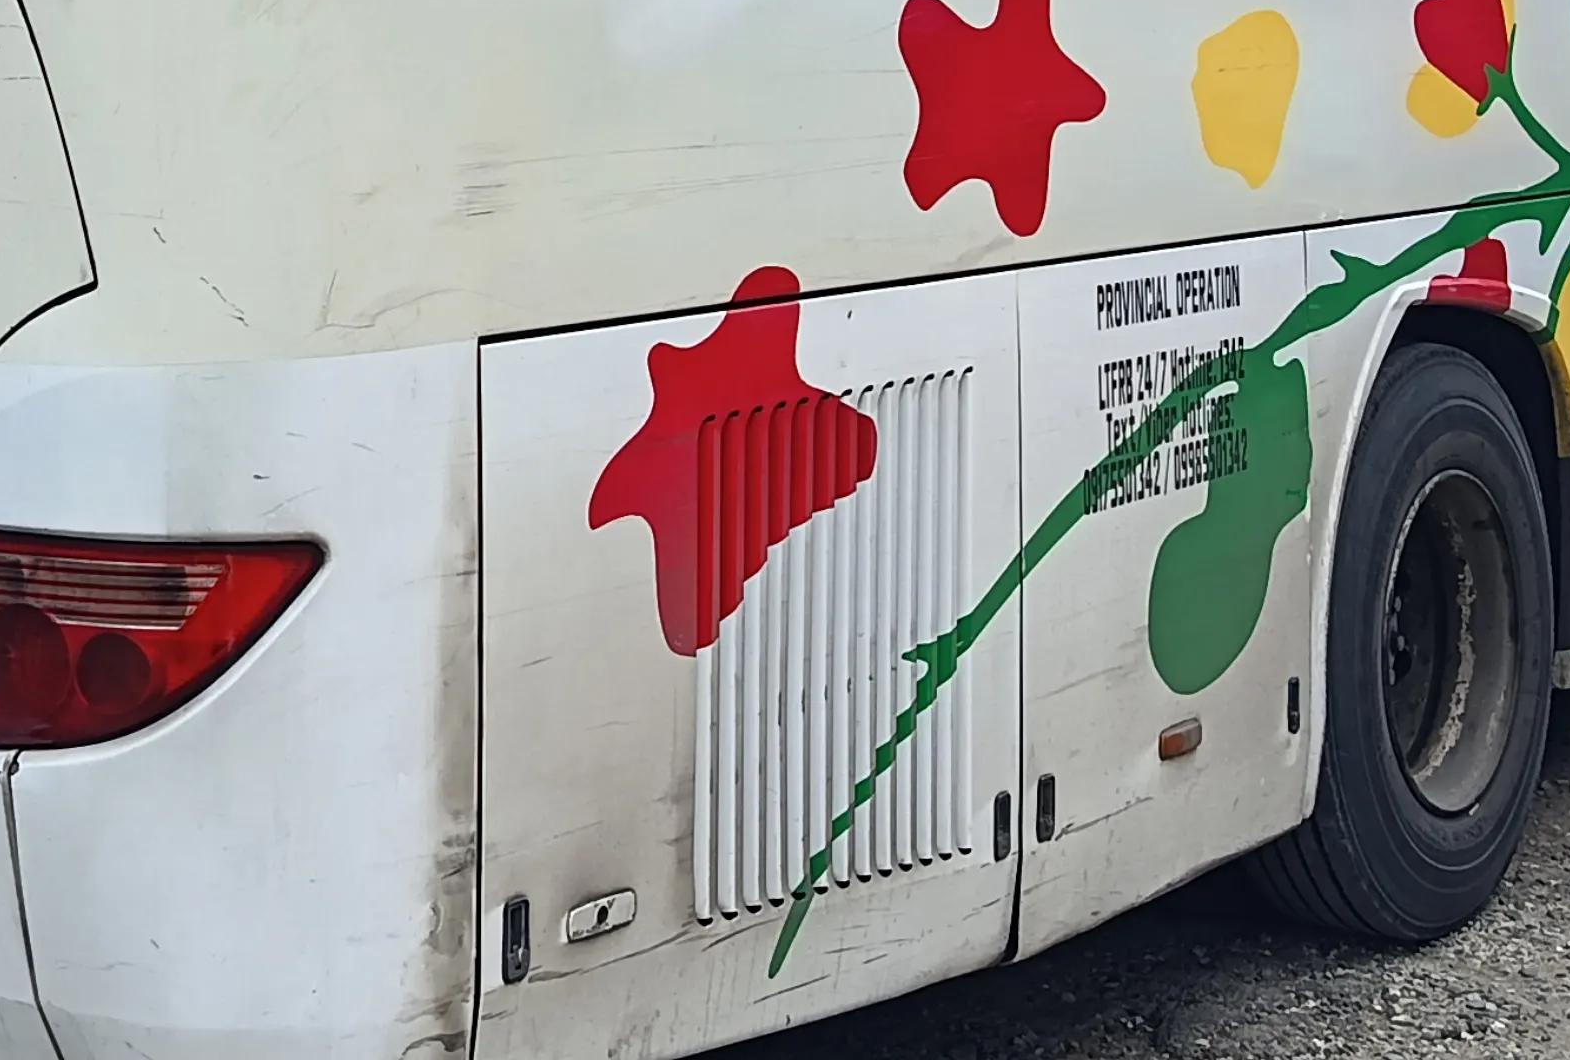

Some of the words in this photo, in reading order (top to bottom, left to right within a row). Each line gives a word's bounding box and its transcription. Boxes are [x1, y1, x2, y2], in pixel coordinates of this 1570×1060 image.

[1097, 275, 1171, 330] PROVINCIAL
[1176, 265, 1240, 316] OPERATION
[1098, 358, 1133, 410] LTFRB
[1137, 351, 1167, 401] 24/7
[1083, 451, 1160, 515] 09175501342
[1174, 428, 1247, 490] 09985501342
